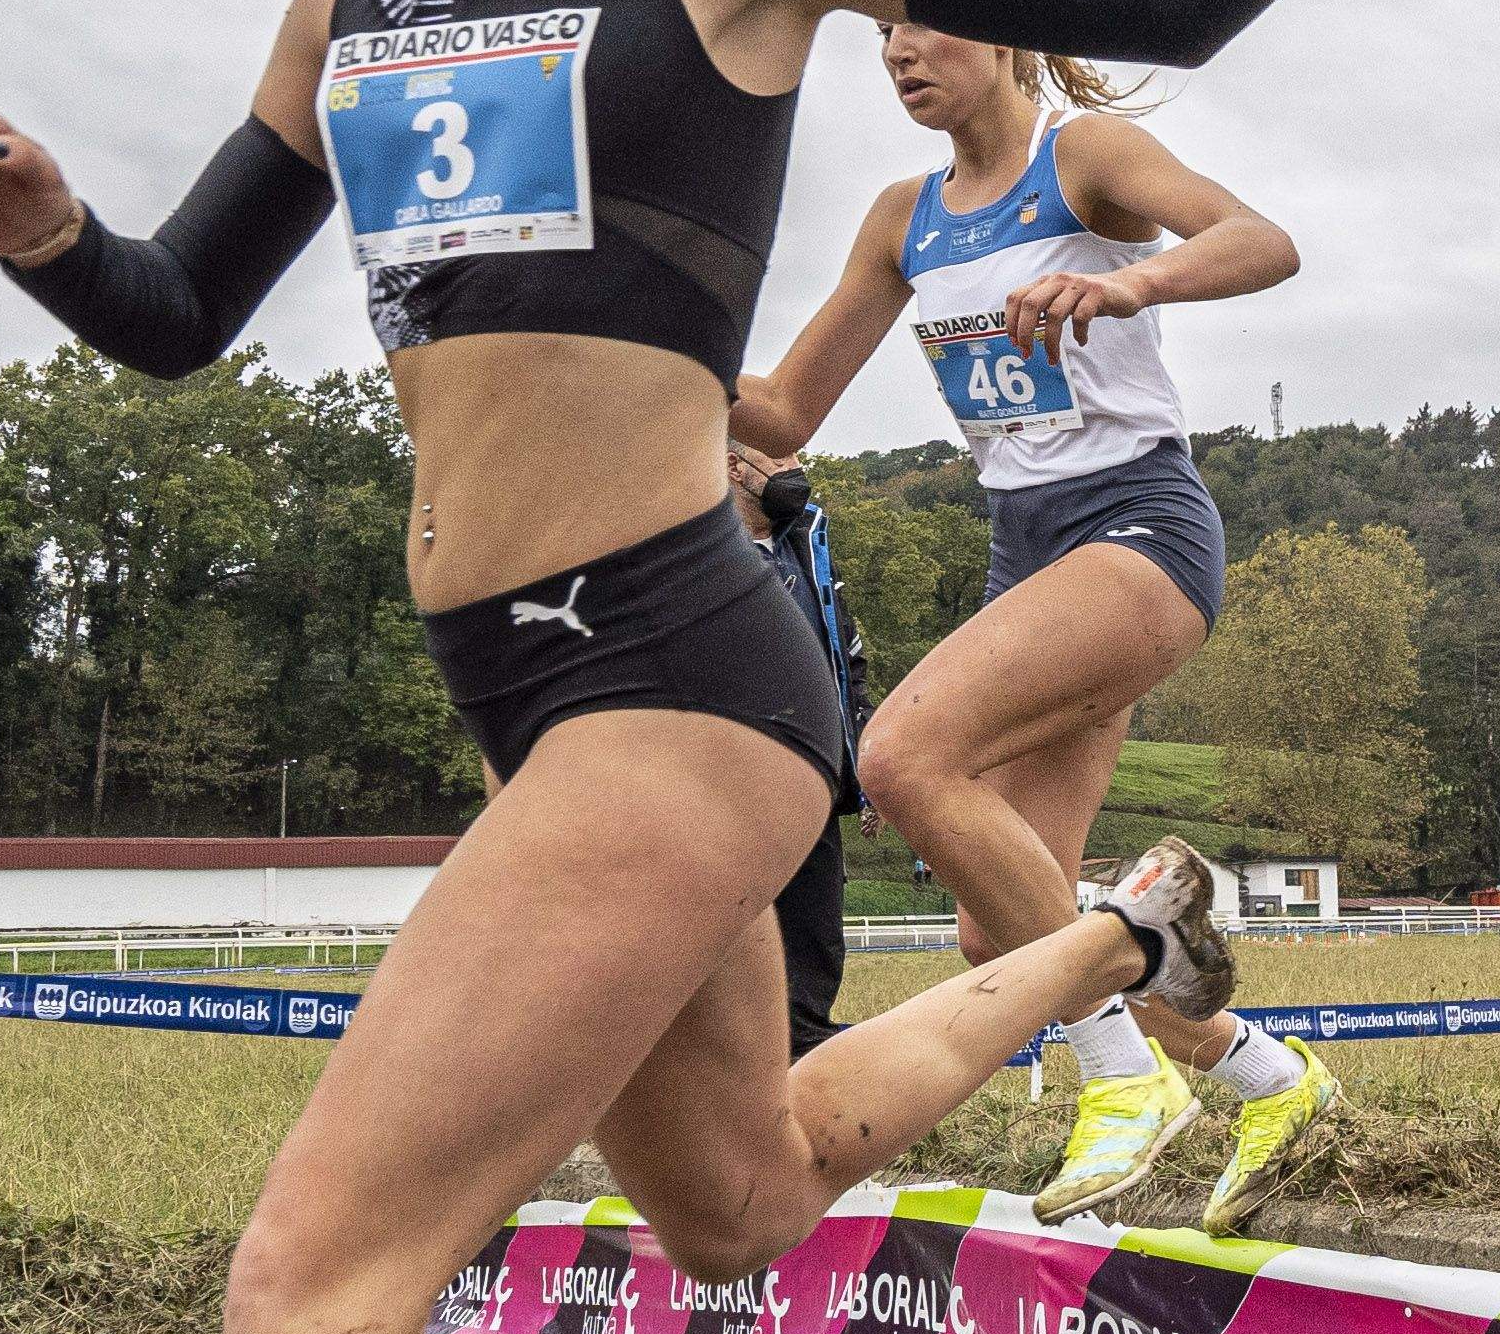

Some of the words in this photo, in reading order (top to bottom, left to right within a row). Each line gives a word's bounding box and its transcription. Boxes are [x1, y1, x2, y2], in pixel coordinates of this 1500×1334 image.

[336, 43, 363, 69] EL
[368, 26, 473, 63] DIARIO
[481, 13, 584, 49] VASCO
[411, 100, 475, 199] 3
[916, 324, 936, 339] EL
[936, 314, 987, 337] DIARIO
[967, 355, 1036, 408] 46
[69, 990, 182, 1017] Gipuzkoa
[188, 996, 270, 1022] Kirolak
[1265, 1015, 1312, 1032] Kirolak
[1337, 1012, 1394, 1031] Gipuzkoa
[1396, 1010, 1438, 1026] Kirolak
[541, 1266, 619, 1307] LABORAL
[670, 1269, 764, 1315] LABORAL
[826, 1271, 947, 1334] LABORAL
[439, 1299, 487, 1329] kutxa
